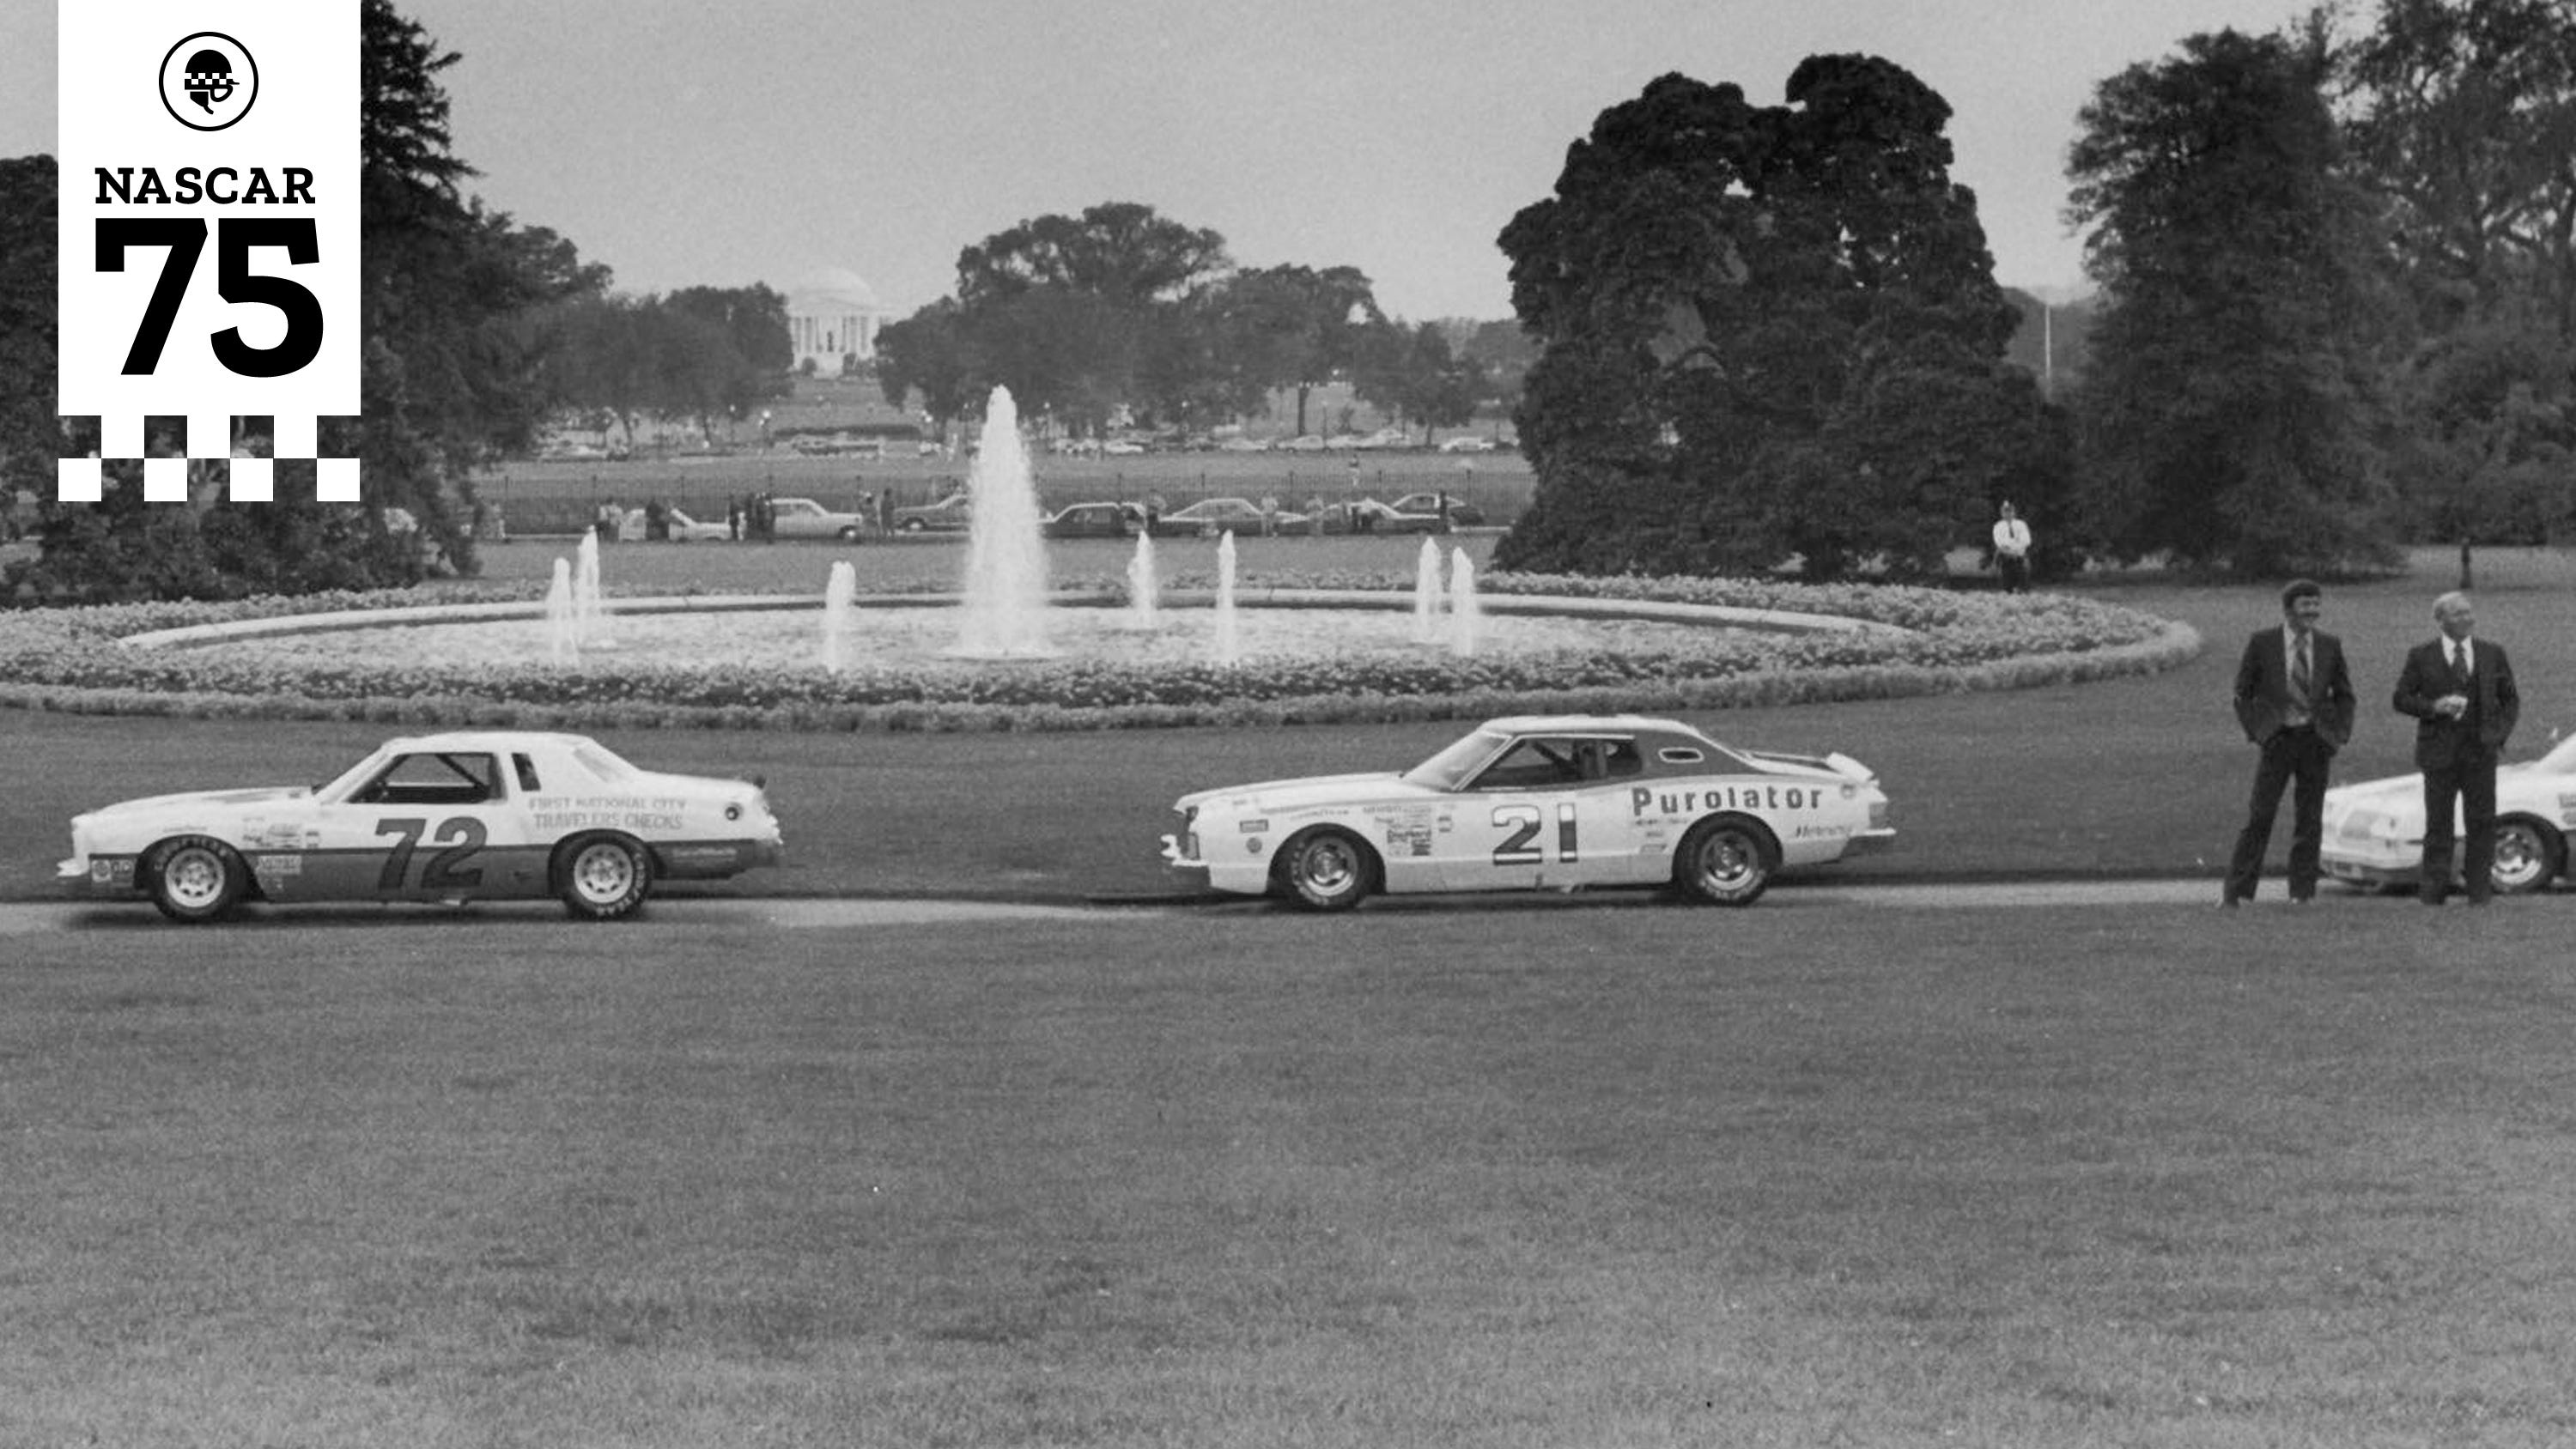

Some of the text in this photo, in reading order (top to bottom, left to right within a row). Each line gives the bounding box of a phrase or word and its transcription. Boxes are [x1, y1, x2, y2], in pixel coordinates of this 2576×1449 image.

[528, 797, 571, 809] FIRST
[652, 797, 688, 809] CITY
[1632, 785, 1822, 816] Purolator
[624, 812, 684, 830] CHECKS
[1492, 803, 1578, 866] 21
[375, 815, 488, 889] 72
